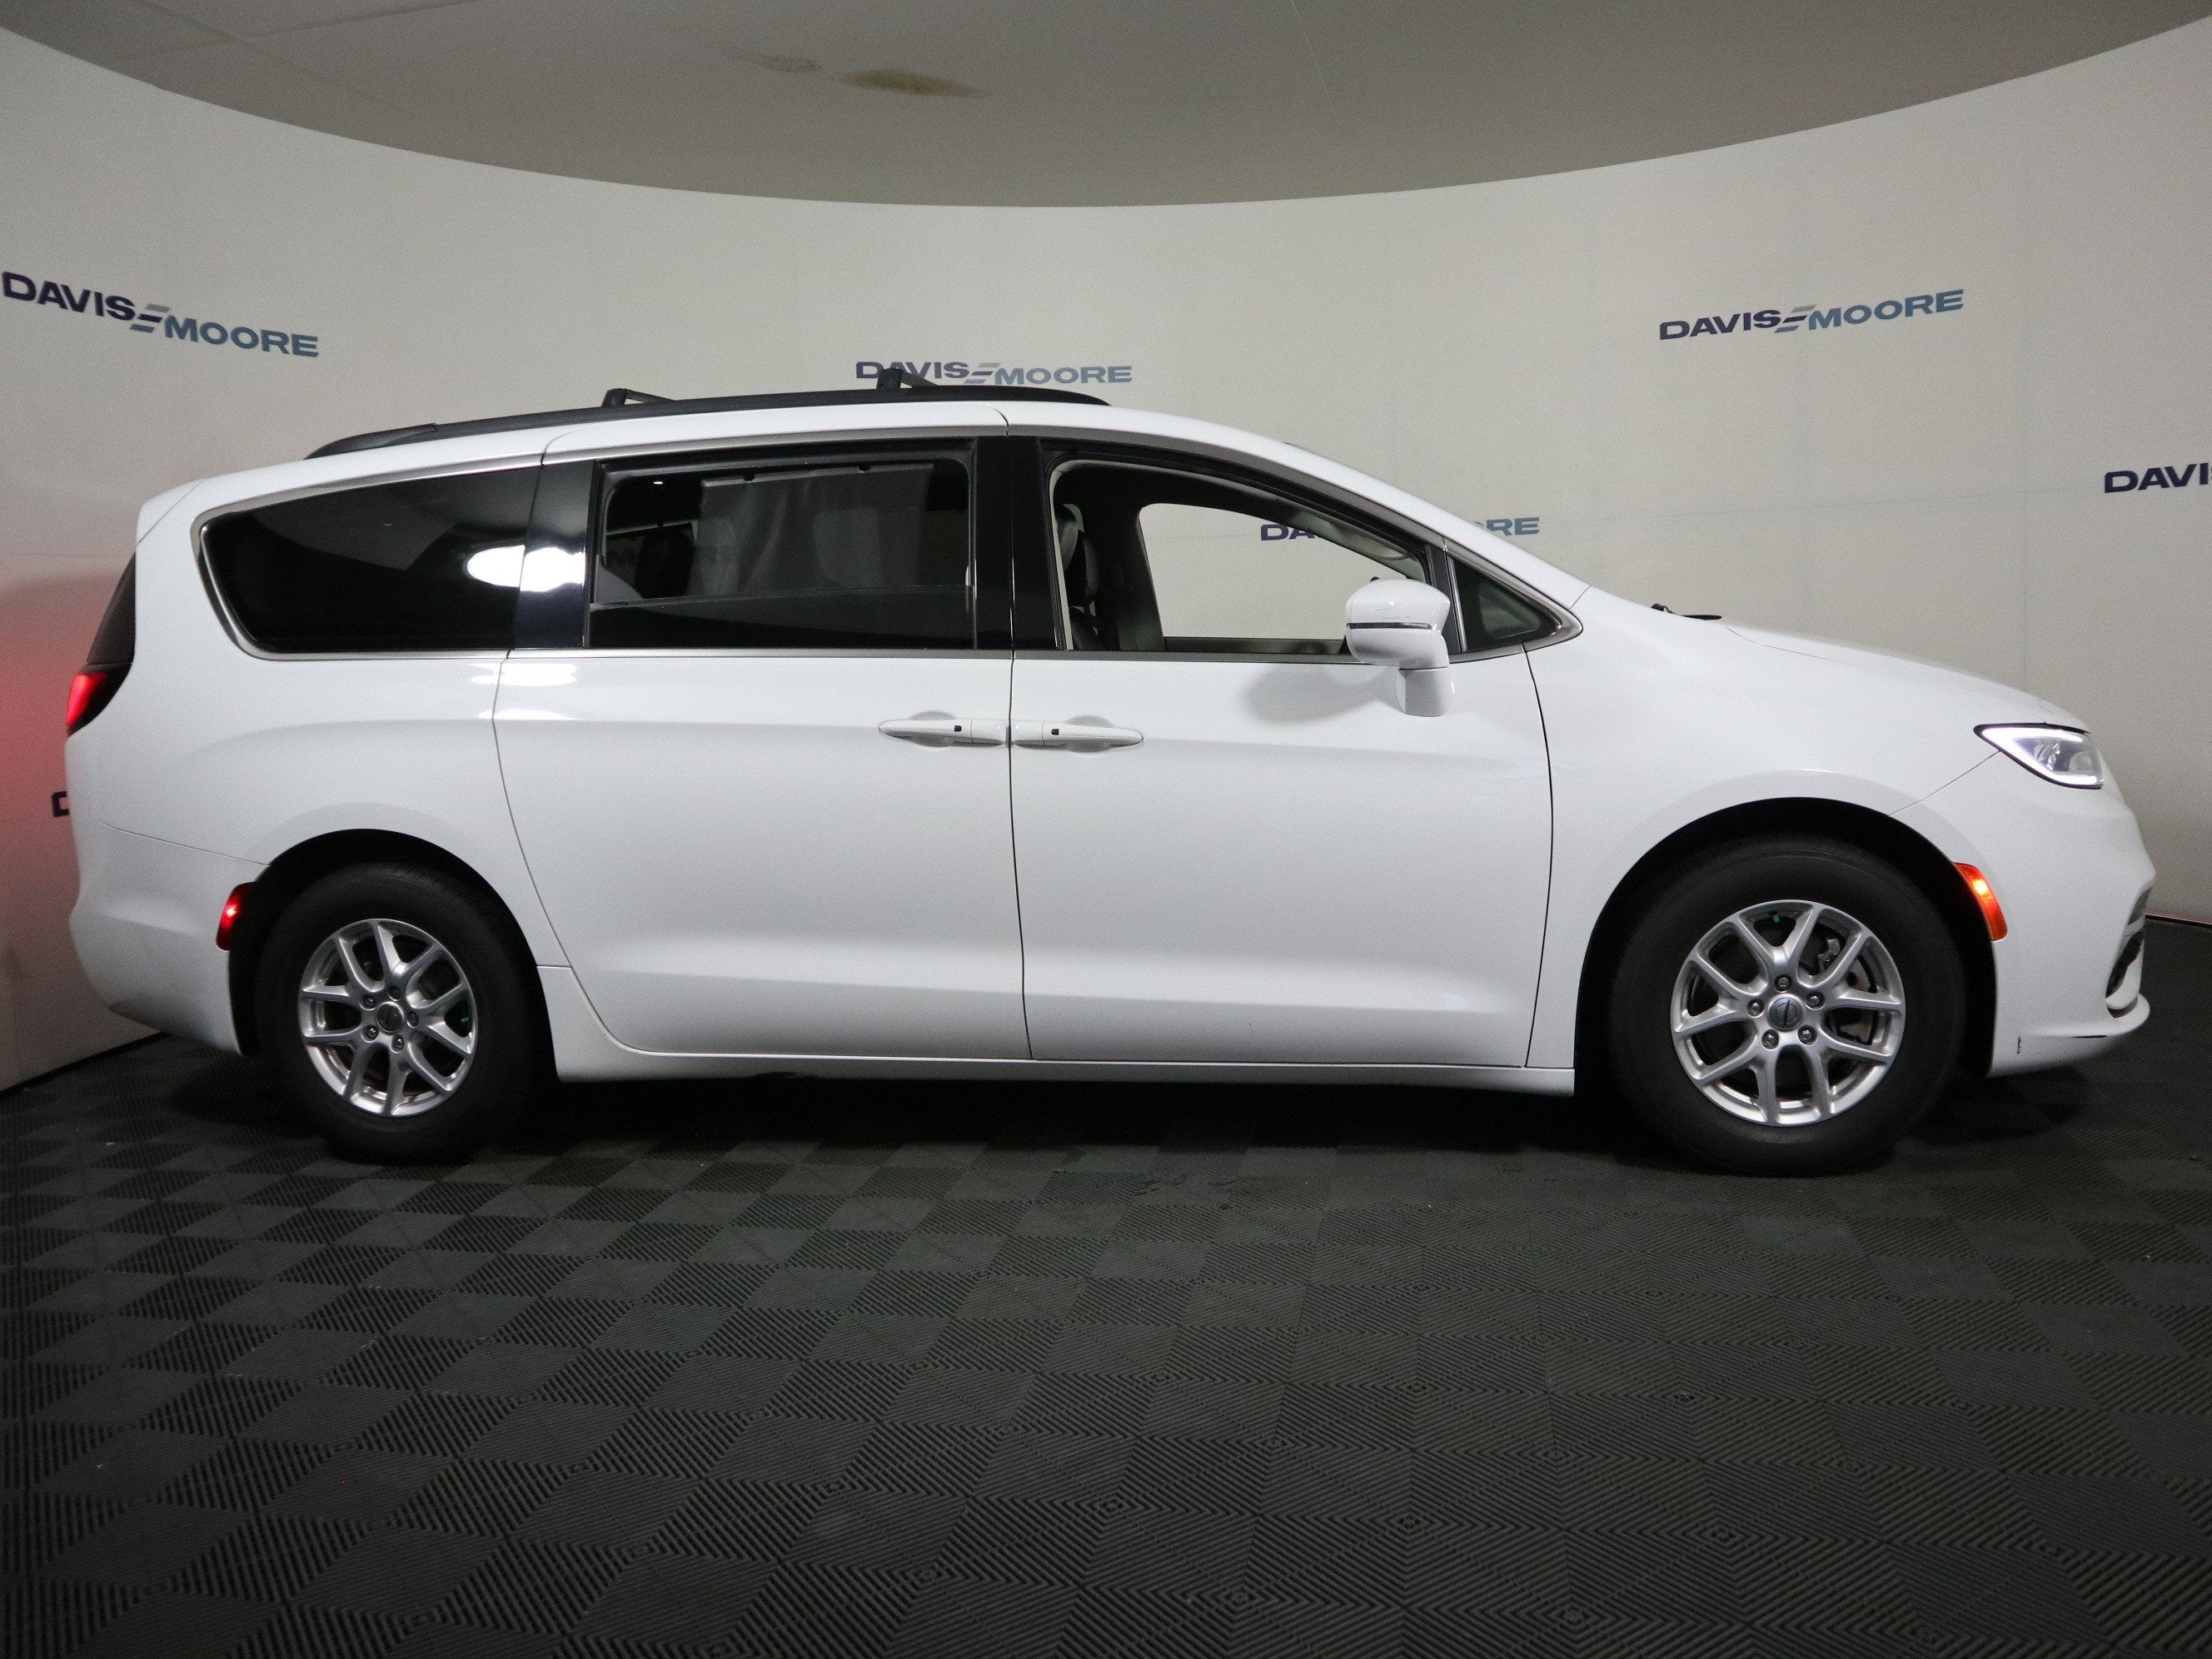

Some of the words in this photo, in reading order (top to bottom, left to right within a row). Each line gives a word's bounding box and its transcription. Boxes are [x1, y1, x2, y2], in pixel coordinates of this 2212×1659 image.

[2, 272, 137, 321] DAVIS
[164, 315, 320, 357] MOORE
[1659, 309, 1781, 341] DAVIS
[1808, 289, 1964, 331] MOORE
[994, 365, 1133, 385] MOORE
[2105, 462, 2212, 493] DAVI
